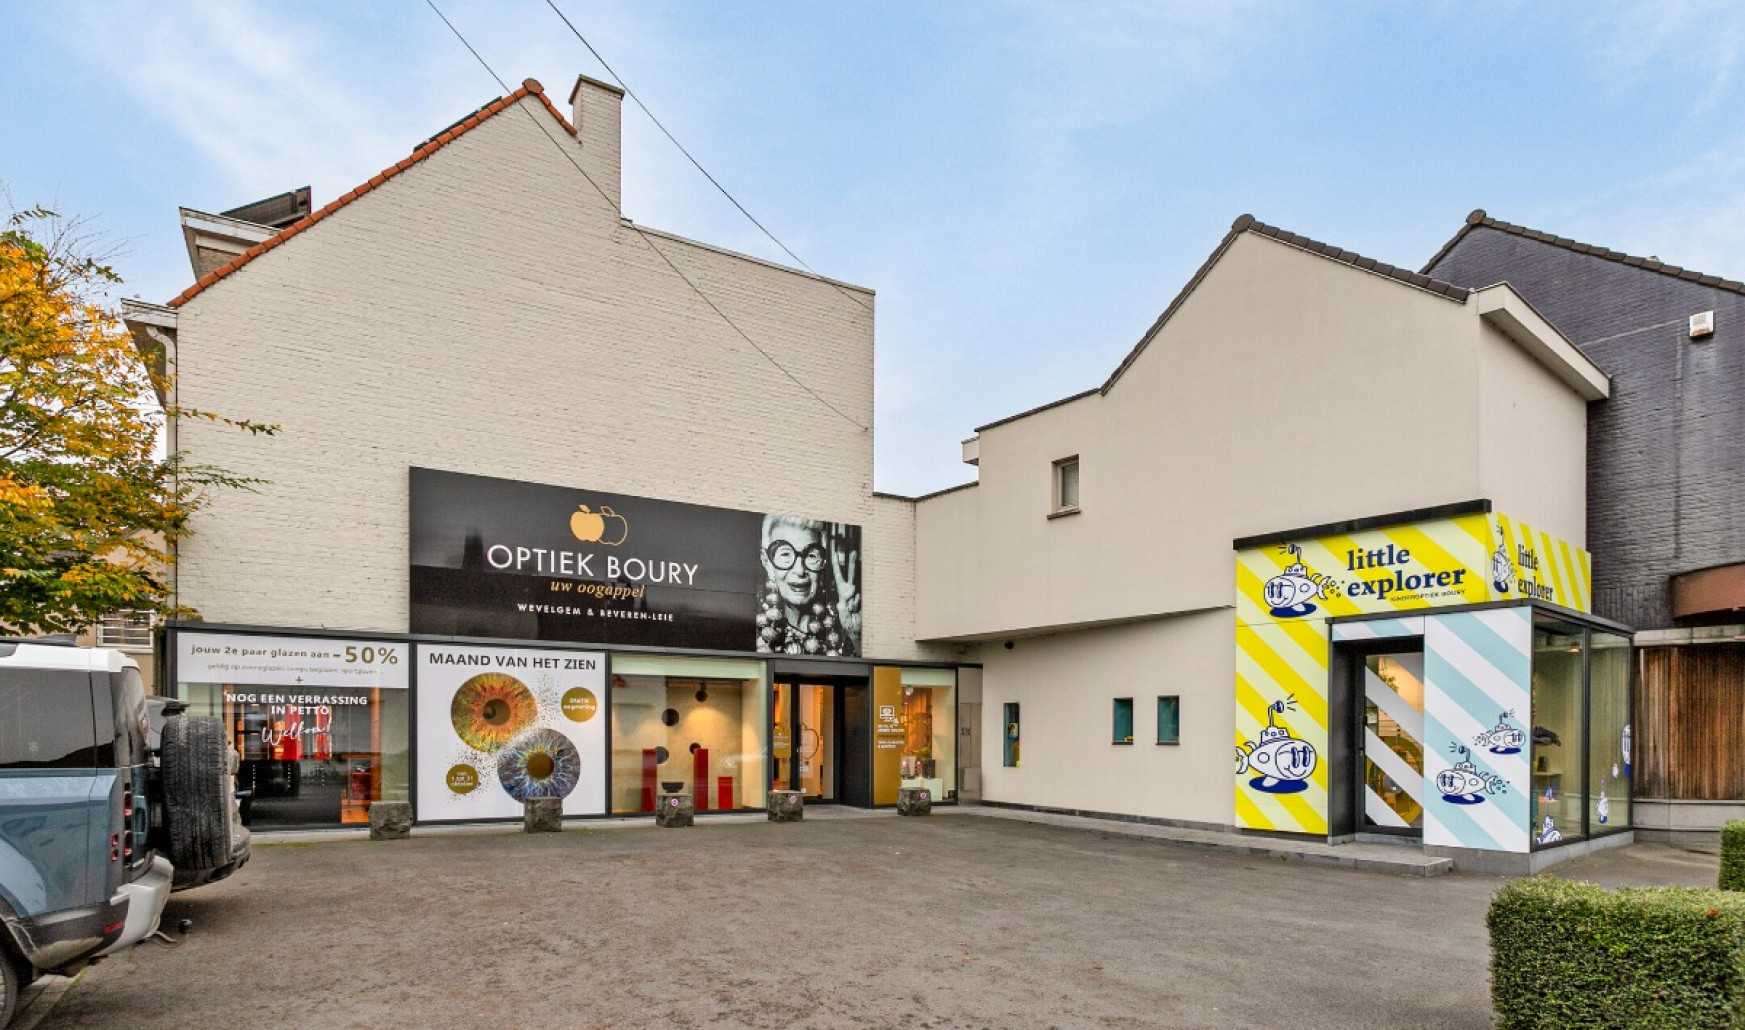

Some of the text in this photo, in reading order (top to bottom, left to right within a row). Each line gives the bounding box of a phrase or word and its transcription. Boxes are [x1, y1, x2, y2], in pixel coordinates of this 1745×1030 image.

[487, 544, 699, 586] OPTIEK BOURY
[1347, 543, 1410, 571] little
[1517, 543, 1538, 571] little
[550, 581, 645, 600] uw oogappel
[1347, 568, 1466, 600] explorer
[1517, 575, 1554, 602] explorer
[517, 603, 675, 622] WEVELGEM & BEVEREN-LEIE
[191, 644, 221, 655] jouw
[224, 646, 238, 655] 2e
[242, 648, 267, 657] paar
[270, 649, 308, 659] glazen
[310, 651, 330, 659] aan
[429, 652, 596, 670] MAAND VAN HET ZIEN
[231, 664, 240, 672] op
[227, 693, 368, 705] NOG EEN VERRASSING
[271, 705, 330, 715] IN PETTO
